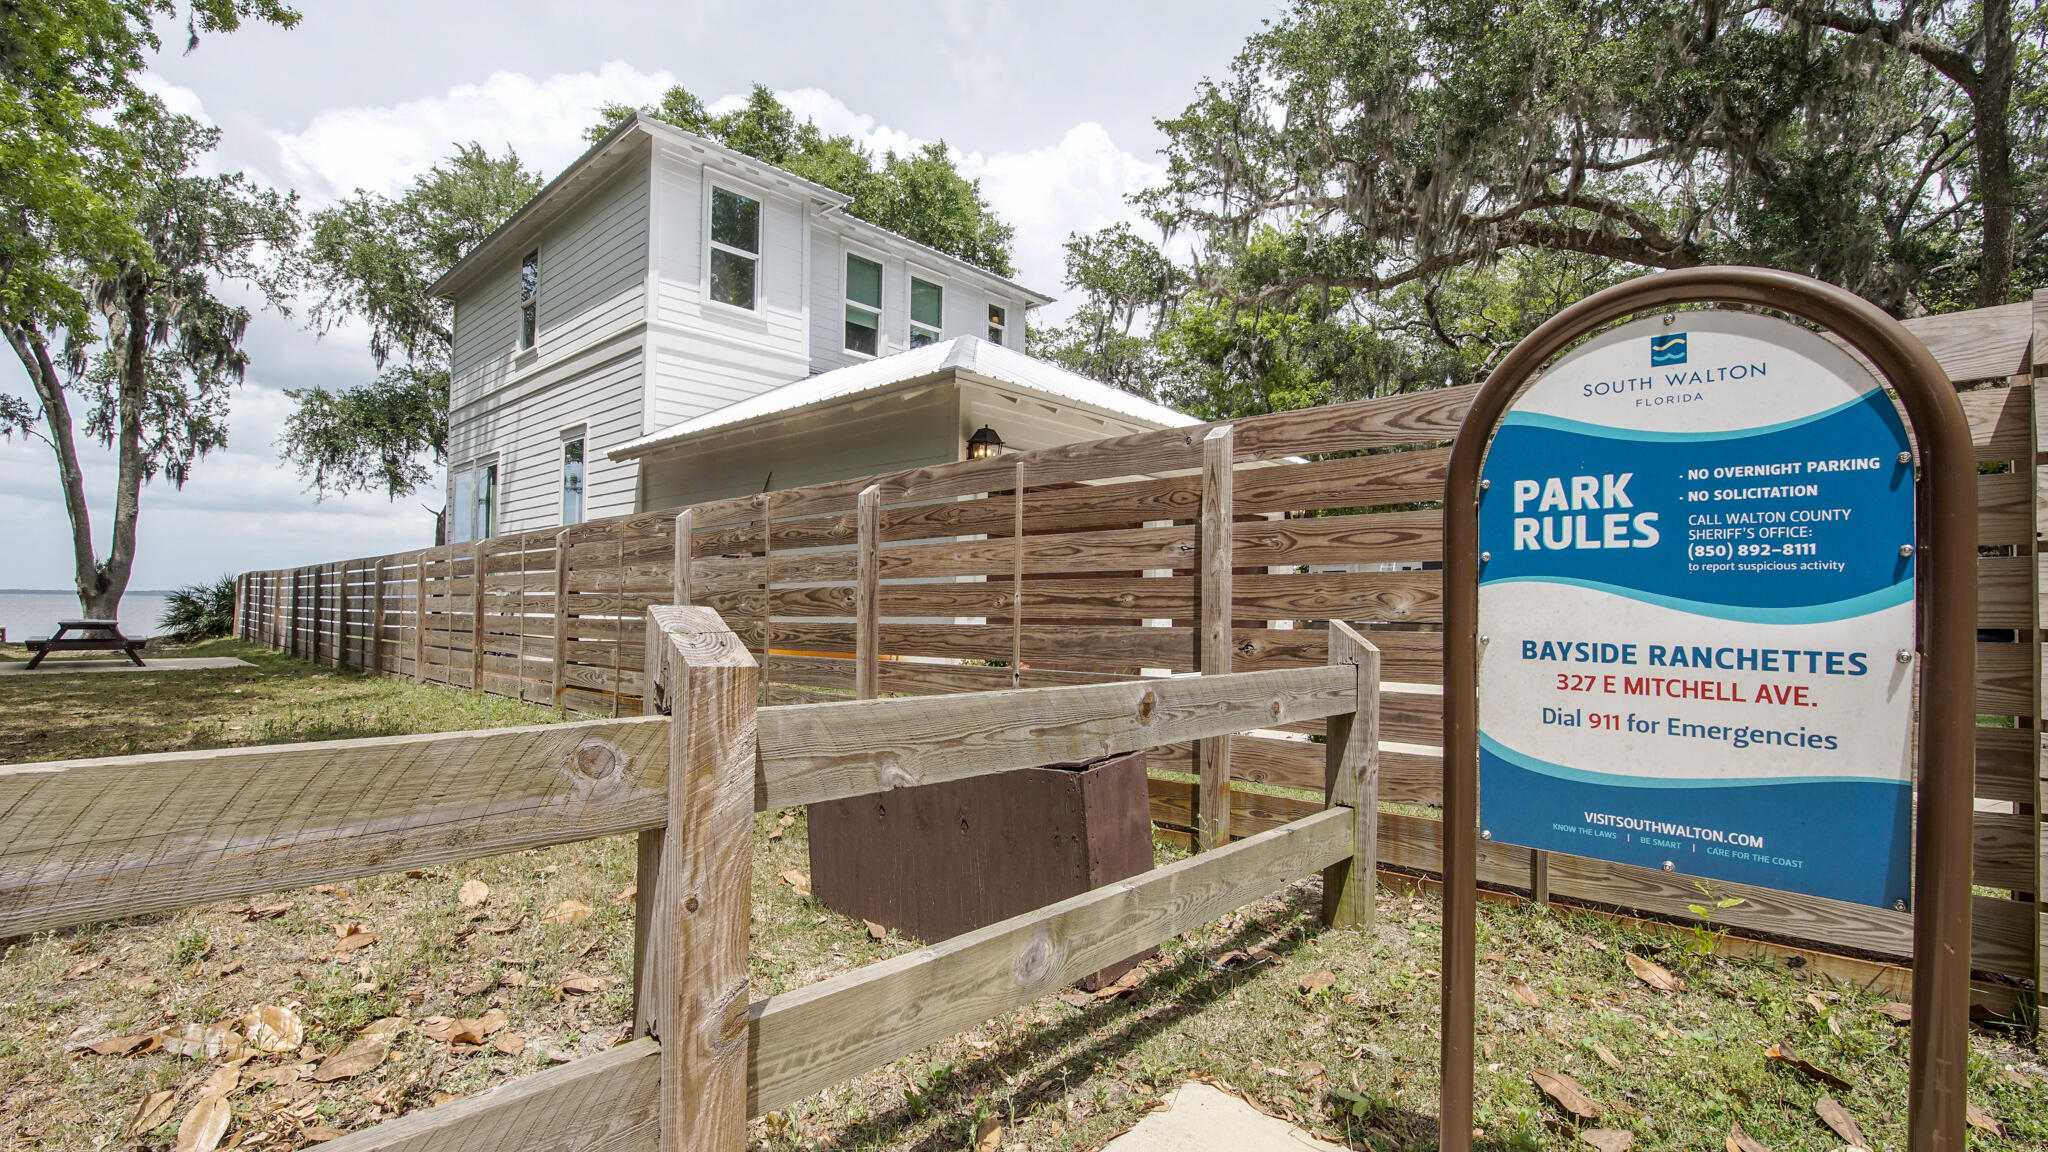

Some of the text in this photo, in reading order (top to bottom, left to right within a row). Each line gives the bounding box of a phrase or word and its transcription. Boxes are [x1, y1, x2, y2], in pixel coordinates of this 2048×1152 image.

[1583, 362, 1768, 398] SOUTH WALTON
[1636, 393, 1704, 408] FLORIDA
[1688, 458, 1880, 480] NO OVERNIGHT PARKING
[1513, 472, 1634, 513] PARK
[1688, 484, 1818, 502] NO SOLICITATION
[1688, 508, 1851, 526] CALL WALTON COUNTY
[1513, 512, 1660, 550] RULES
[1688, 526, 1813, 540] SHERIFF'S OFFICE:
[1688, 543, 1732, 560] (850)
[1688, 559, 1845, 574] to report suspicious activity
[1522, 640, 1868, 676] BAYSIDE RANCHETTES
[1556, 674, 1818, 707] 327 E MITCHELL AVE.
[1542, 707, 1838, 751] Dial 911 for Emergencies
[1552, 823, 1617, 839] KNOW THE LAWS
[1584, 812, 1763, 849] VISITSOUTHWALTON.COM
[1653, 838, 1681, 849] SMART
[1706, 846, 1803, 868] CARE FOR THE COAST
